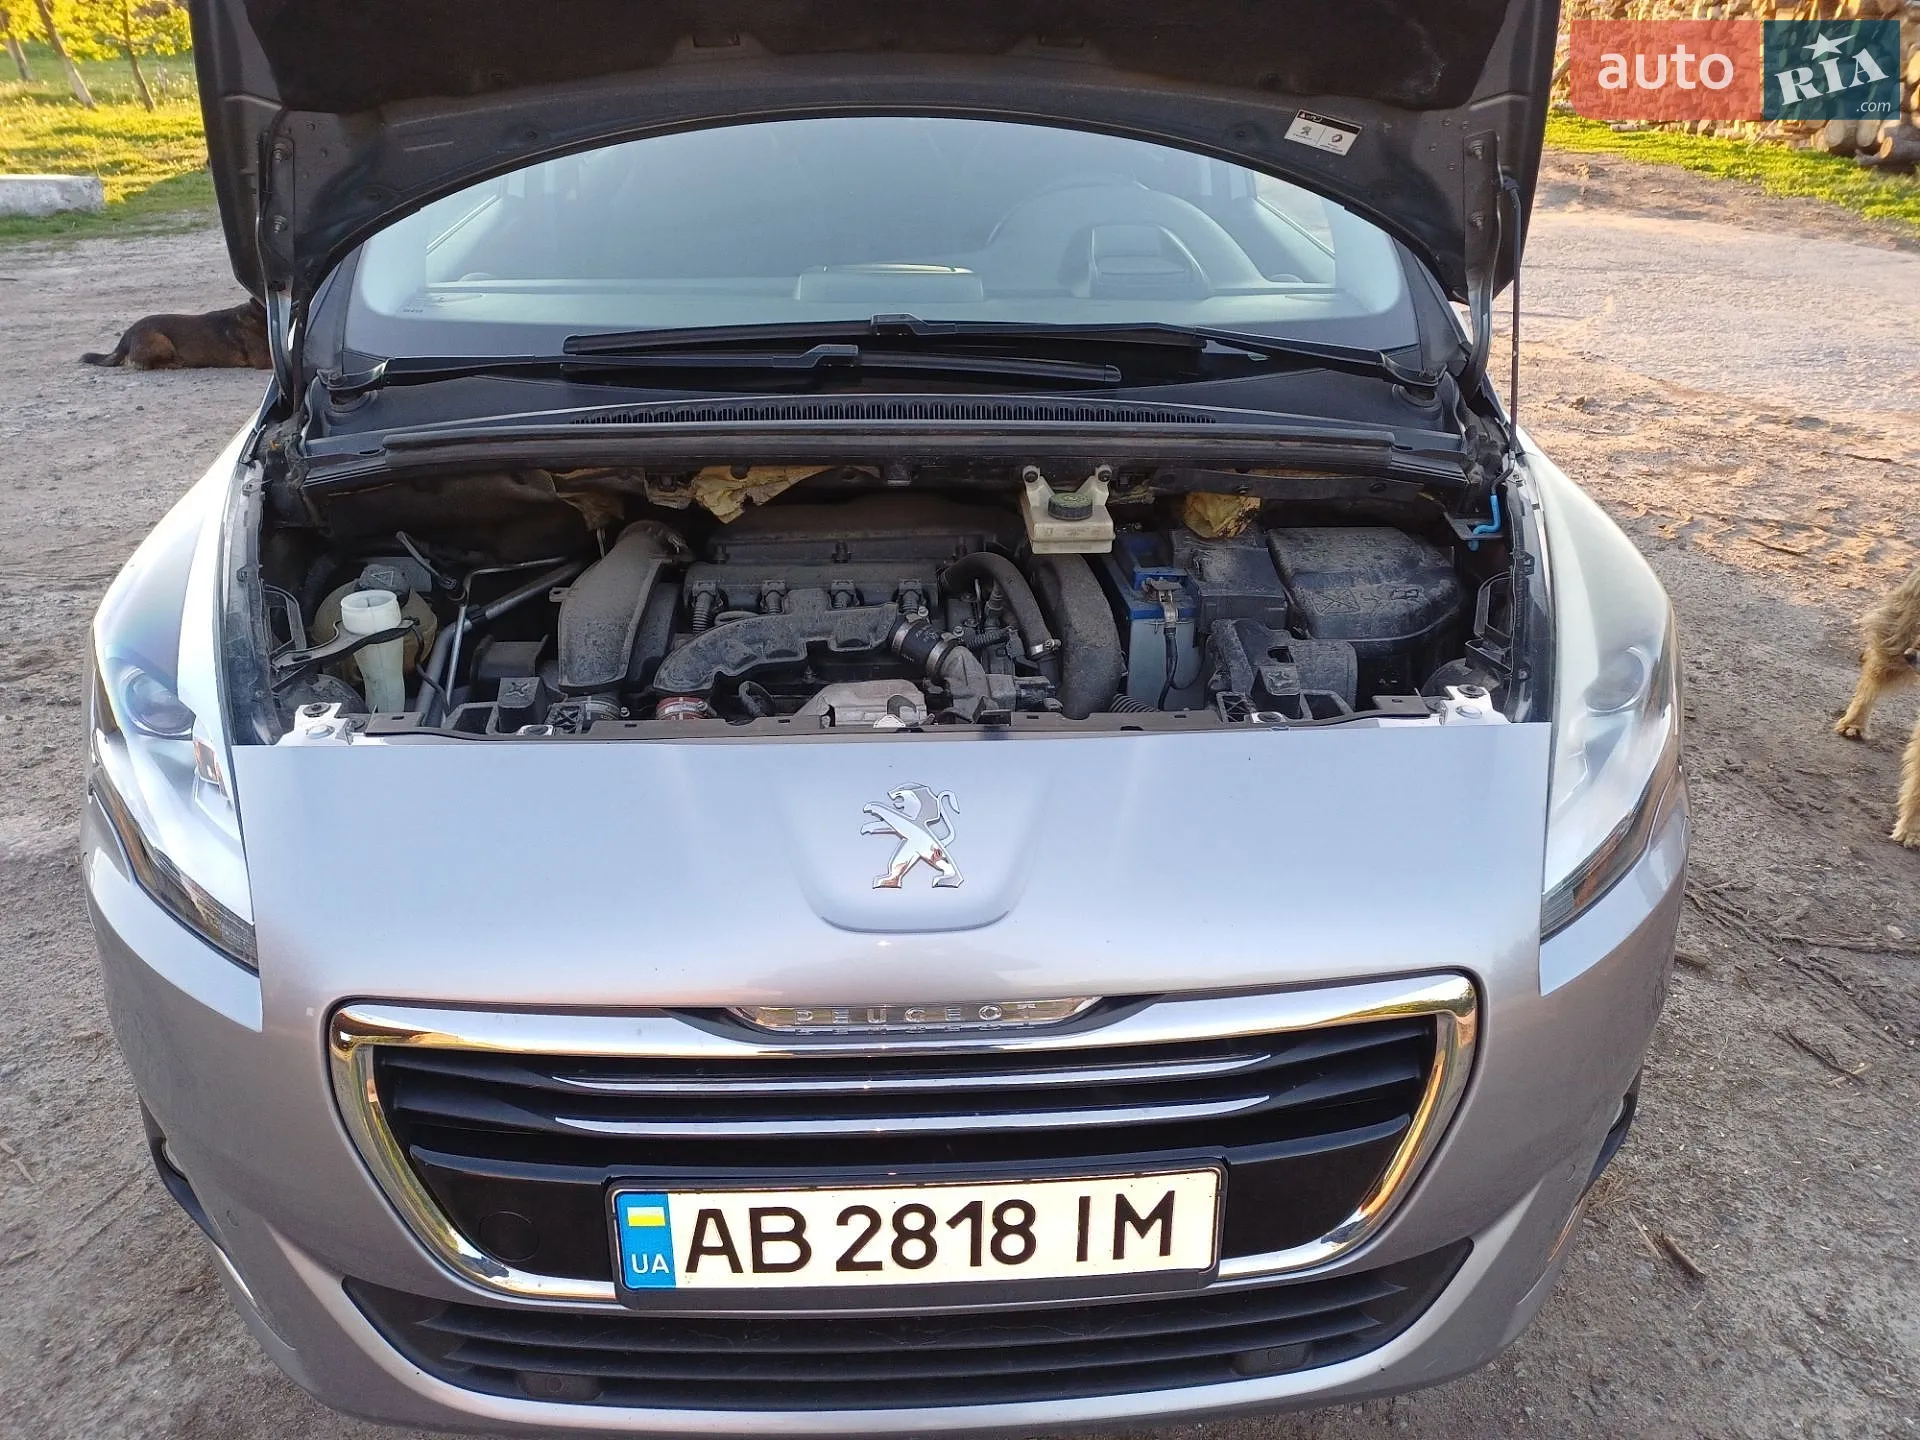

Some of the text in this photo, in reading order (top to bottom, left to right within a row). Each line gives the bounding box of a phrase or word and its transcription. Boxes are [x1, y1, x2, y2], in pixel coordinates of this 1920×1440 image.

[795, 1003, 1037, 1025] PEUGEOT
[685, 1191, 1175, 1274] AB 2818 IM
[631, 1253, 669, 1275] UA
